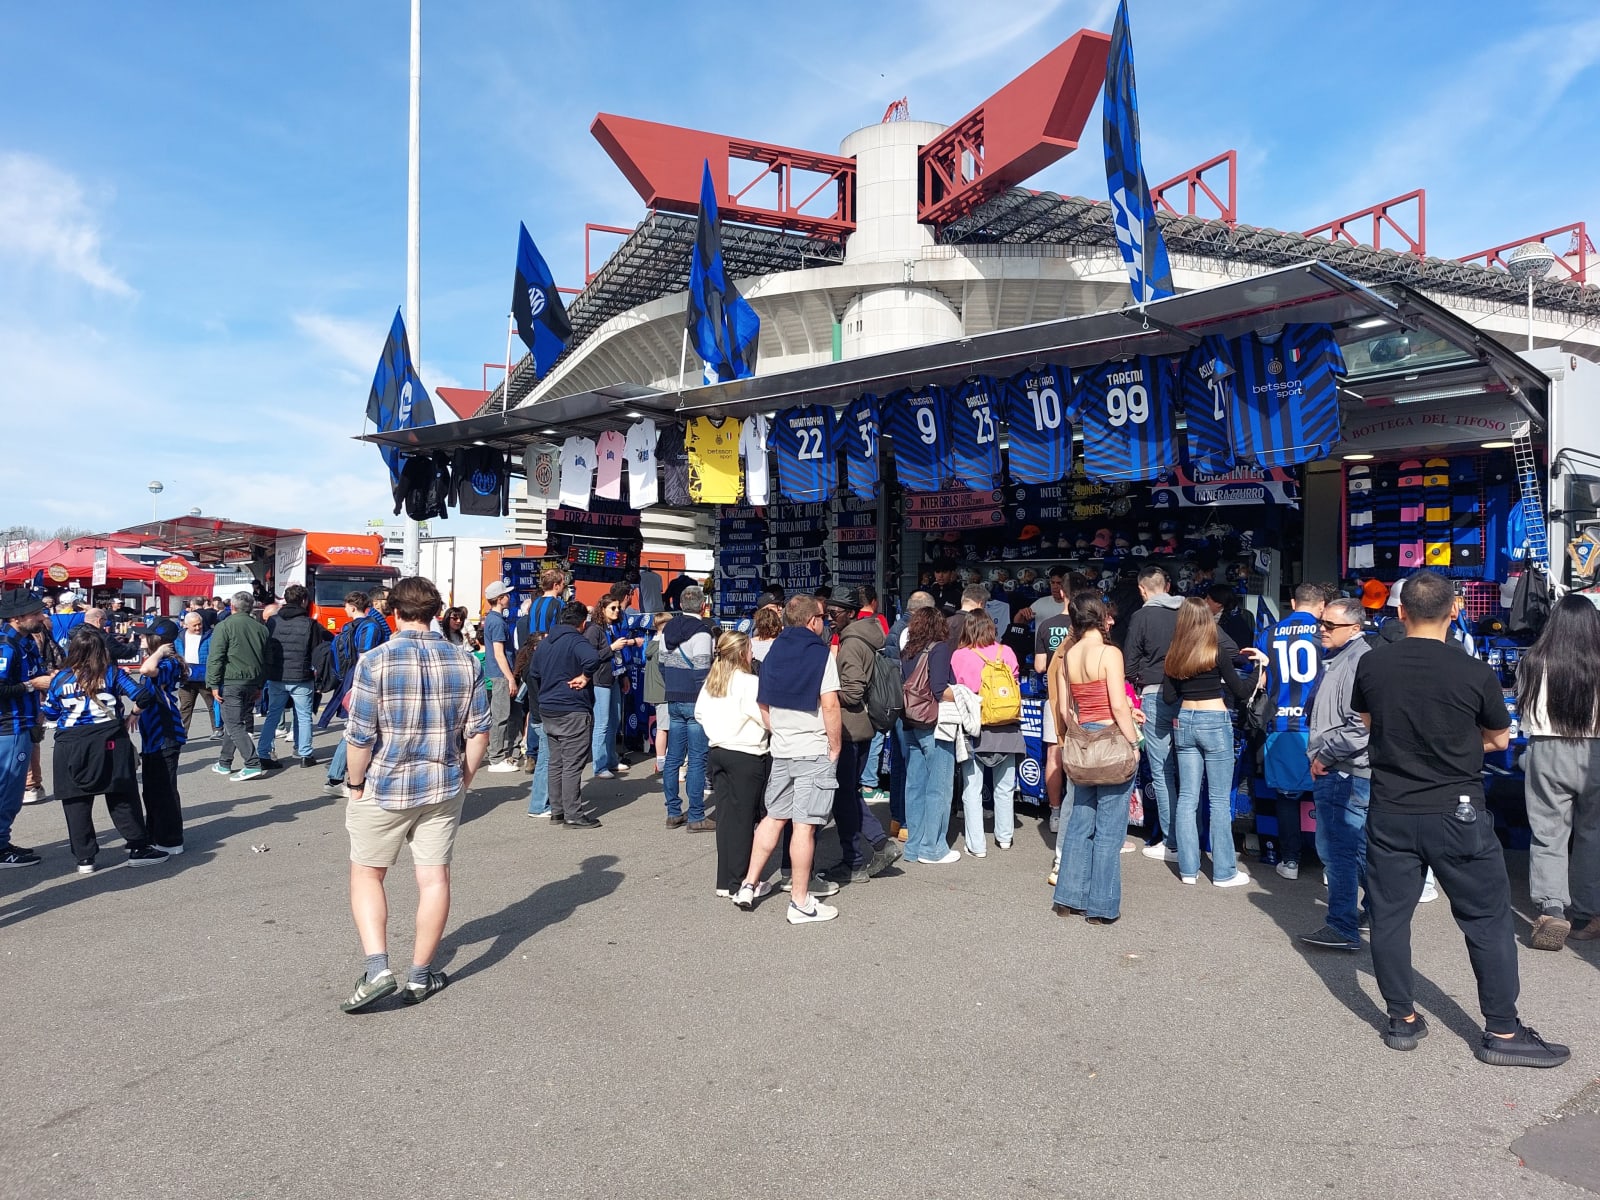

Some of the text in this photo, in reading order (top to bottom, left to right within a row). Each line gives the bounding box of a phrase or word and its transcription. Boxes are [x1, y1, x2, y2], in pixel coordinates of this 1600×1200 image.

[1106, 369, 1144, 386] TAREMI
[1252, 380, 1302, 394] betsson
[1276, 387, 1303, 399] sport
[1027, 388, 1061, 431] 10
[1106, 385, 1149, 427] 99
[916, 407, 937, 445] 9
[972, 406, 995, 445] 23
[1352, 417, 1415, 439] BOTTEGA
[1421, 414, 1449, 424] DEL
[1455, 415, 1506, 432] TIFOSO
[796, 427, 824, 461] 22
[1193, 465, 1265, 483] FORZA INTER
[1040, 486, 1062, 499] INTER
[920, 495, 959, 508] INTER GIRLS
[805, 503, 824, 518] INTER
[1040, 507, 1062, 519] INTER
[563, 510, 623, 526] FORZA INTER
[732, 520, 746, 529] INTER
[853, 513, 872, 526] INTER
[919, 515, 958, 528] INTER GIRLS
[776, 520, 811, 533] FORZA INTER
[520, 562, 535, 570] INTER
[789, 562, 811, 577] INTER
[519, 577, 534, 585] INTER
[735, 580, 749, 589] INTER
[787, 579, 808, 588] STATI
[809, 578, 818, 587] IN
[726, 592, 757, 602] FORZA INTER
[723, 606, 736, 615] INTER
[1010, 625, 1025, 634] INTER
[1274, 625, 1317, 637] LAUTARO
[1272, 639, 1318, 684] 10
